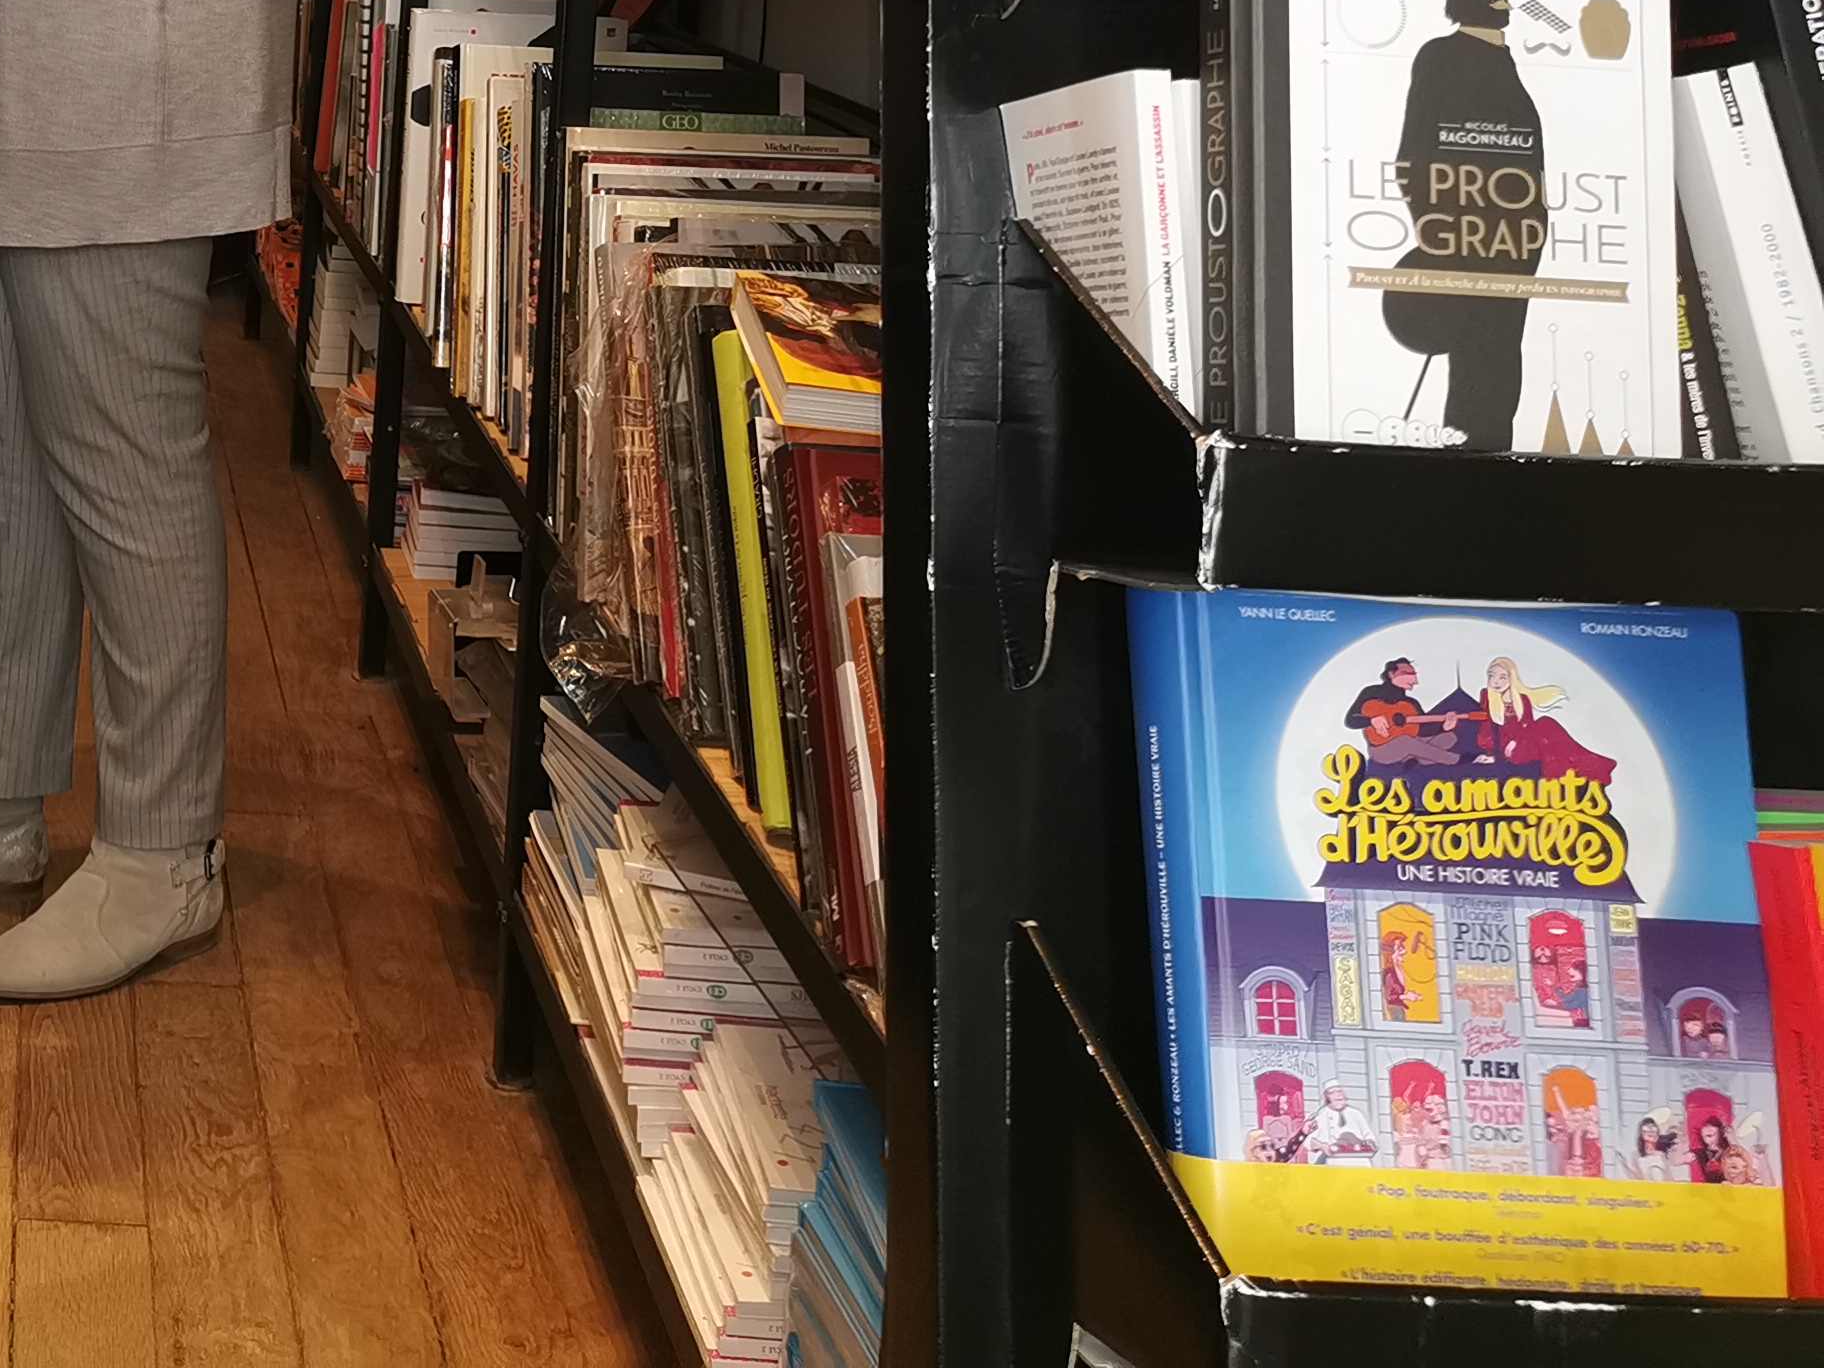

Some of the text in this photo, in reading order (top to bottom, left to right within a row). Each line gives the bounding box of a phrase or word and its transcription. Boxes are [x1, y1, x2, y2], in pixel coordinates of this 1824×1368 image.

[661, 113, 700, 130] GEO
[1464, 120, 1508, 132] NICOLAS
[1438, 131, 1535, 149] RAGONNEAU
[1347, 159, 1629, 215] LE PROUST
[1156, 182, 1172, 240] GARÇONNE
[1205, 29, 1229, 388] PROUSTOGRAPHE
[1346, 209, 1630, 266] OGRAPHE
[1161, 261, 1175, 314] VOLDMAN
[780, 464, 811, 615] TUDORS
[1237, 606, 1274, 619] YANN
[1275, 607, 1286, 620] LE
[1579, 622, 1689, 639] ROMAIN RONZEAU
[1313, 743, 1612, 817] Les amants
[1316, 809, 1627, 887] d'Hérouville
[1148, 725, 1178, 1030] LES AMANTS D'HÉROUVILLE UNE HISTOIRE VRAIE
[1397, 863, 1561, 889] UNE HISTOIRE VRAIE
[1453, 921, 1511, 944] PINK
[1451, 940, 1513, 964] FLOYD
[1465, 1102, 1526, 1125] JOHN
[1469, 1124, 1525, 1144] GONG
